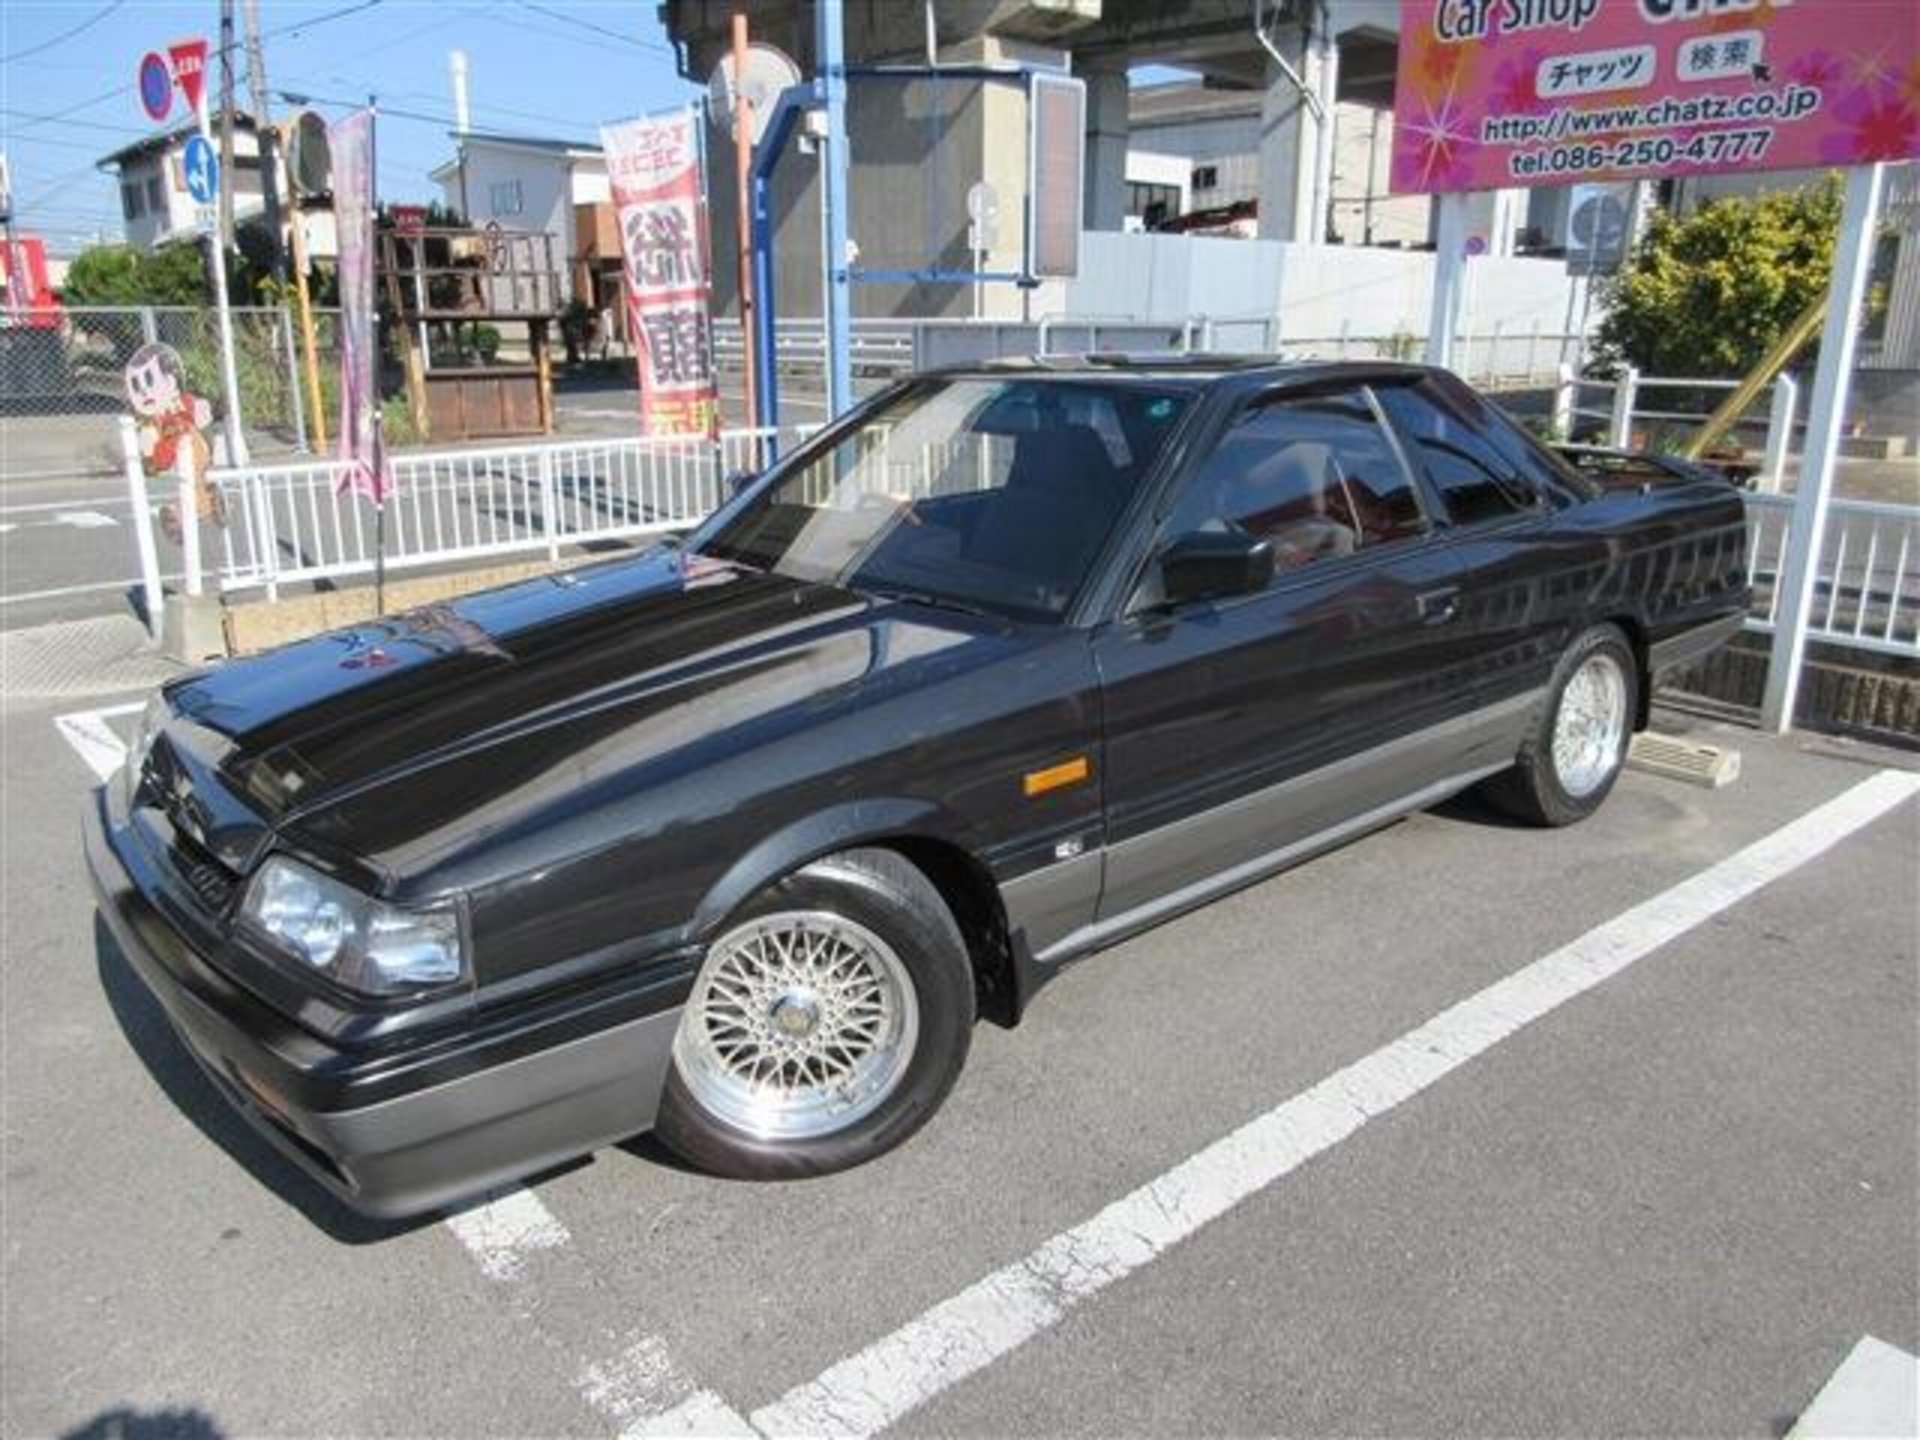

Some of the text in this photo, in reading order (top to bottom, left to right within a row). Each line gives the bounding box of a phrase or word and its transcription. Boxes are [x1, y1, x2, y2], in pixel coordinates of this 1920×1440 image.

[1550, 54, 1643, 88] チャッツ
[1690, 38, 1752, 72] 検索
[1484, 87, 1818, 141] http://www.chatz.co.jp
[1512, 130, 1771, 174] tel.086-250-4777
